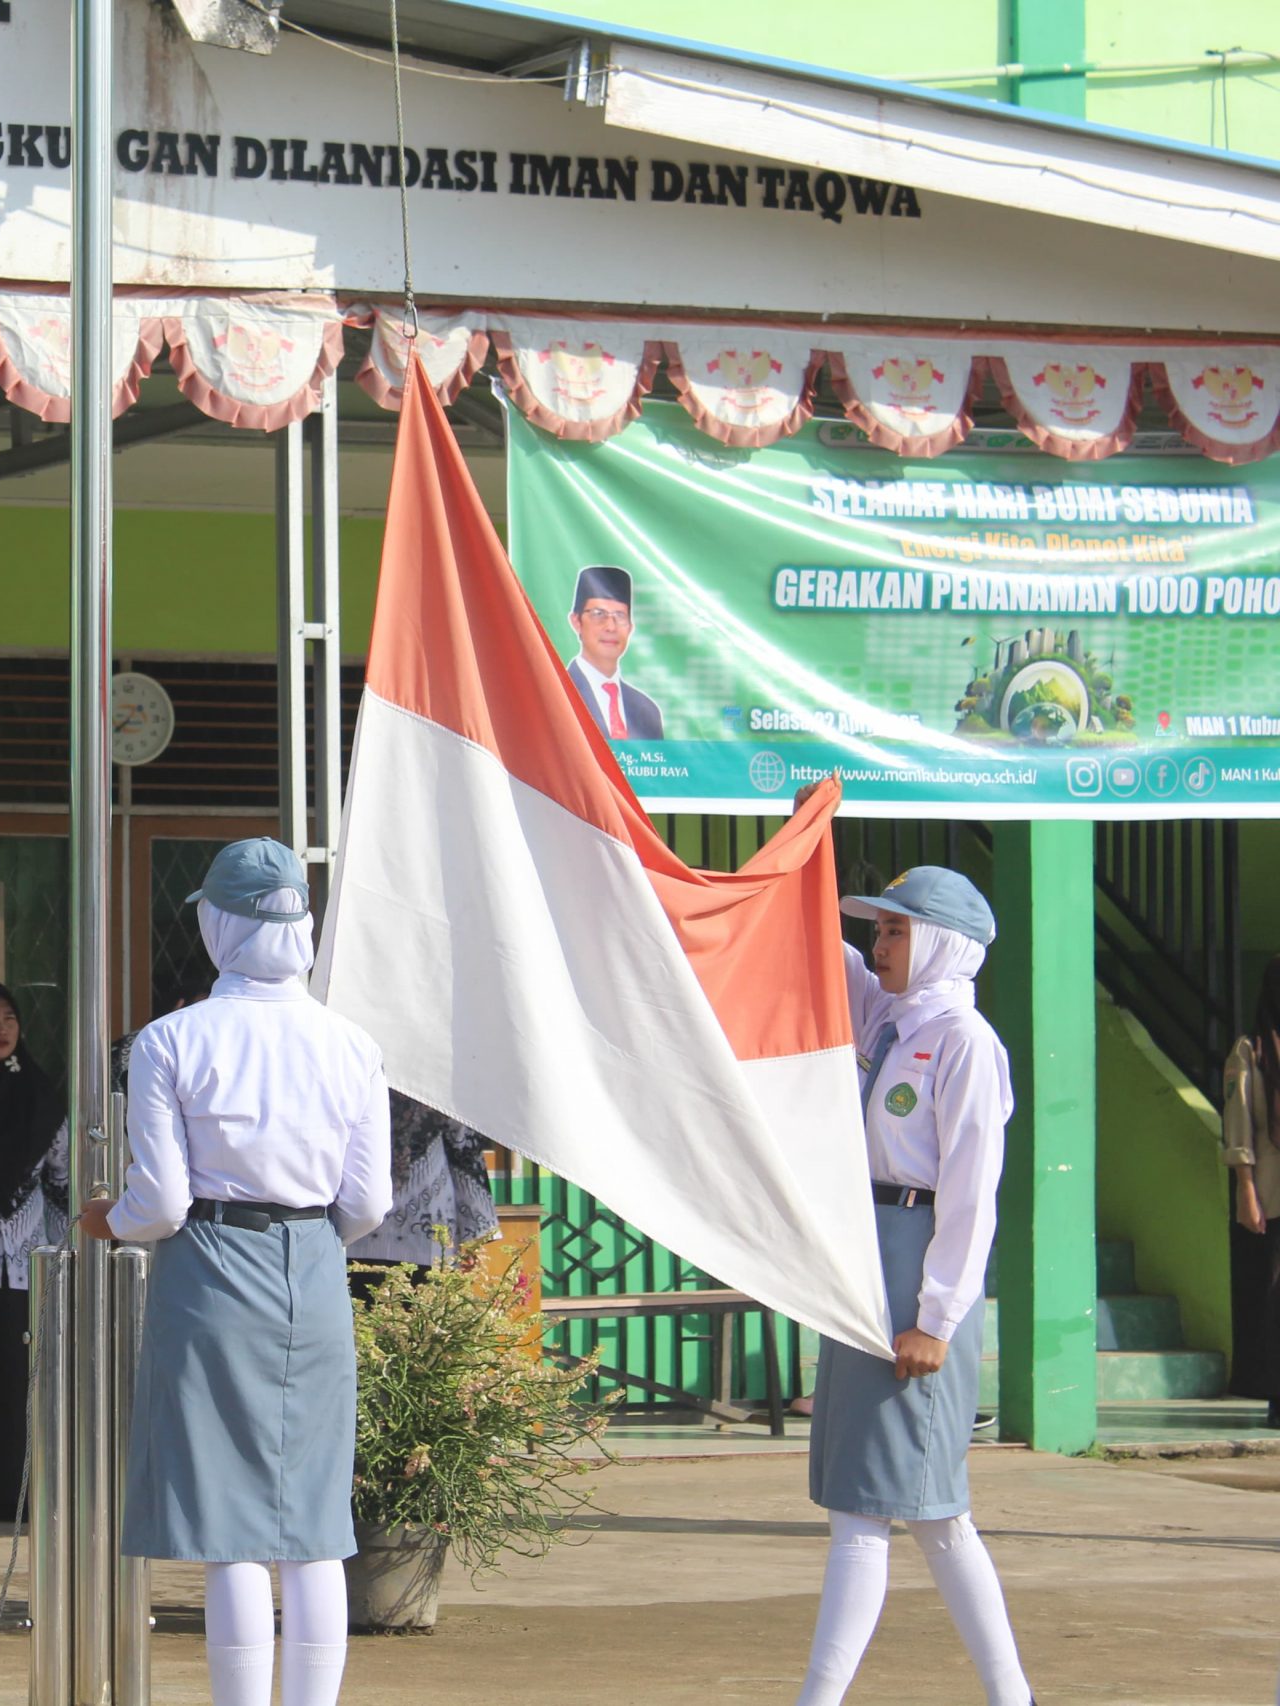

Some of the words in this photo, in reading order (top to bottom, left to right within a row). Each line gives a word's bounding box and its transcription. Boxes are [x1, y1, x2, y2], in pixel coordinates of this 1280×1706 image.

[232, 136, 498, 194] DILANDASI
[509, 152, 639, 202] IMAN
[650, 159, 748, 208] DAN
[756, 166, 922, 224] TAQWA
[811, 480, 947, 518] SELAMAT
[951, 482, 1029, 520] HARI
[1032, 485, 1117, 522] BUMI
[1120, 486, 1255, 524] SEDUNIA
[774, 568, 924, 610] GERAKAN
[930, 571, 1117, 613] PENANAMAN
[1122, 575, 1199, 614] 1000
[1185, 716, 1225, 736] MAN
[1227, 716, 1238, 736] 1
[628, 766, 659, 777] KUBU
[660, 766, 689, 777] RAYA
[1221, 768, 1252, 781] MAN
